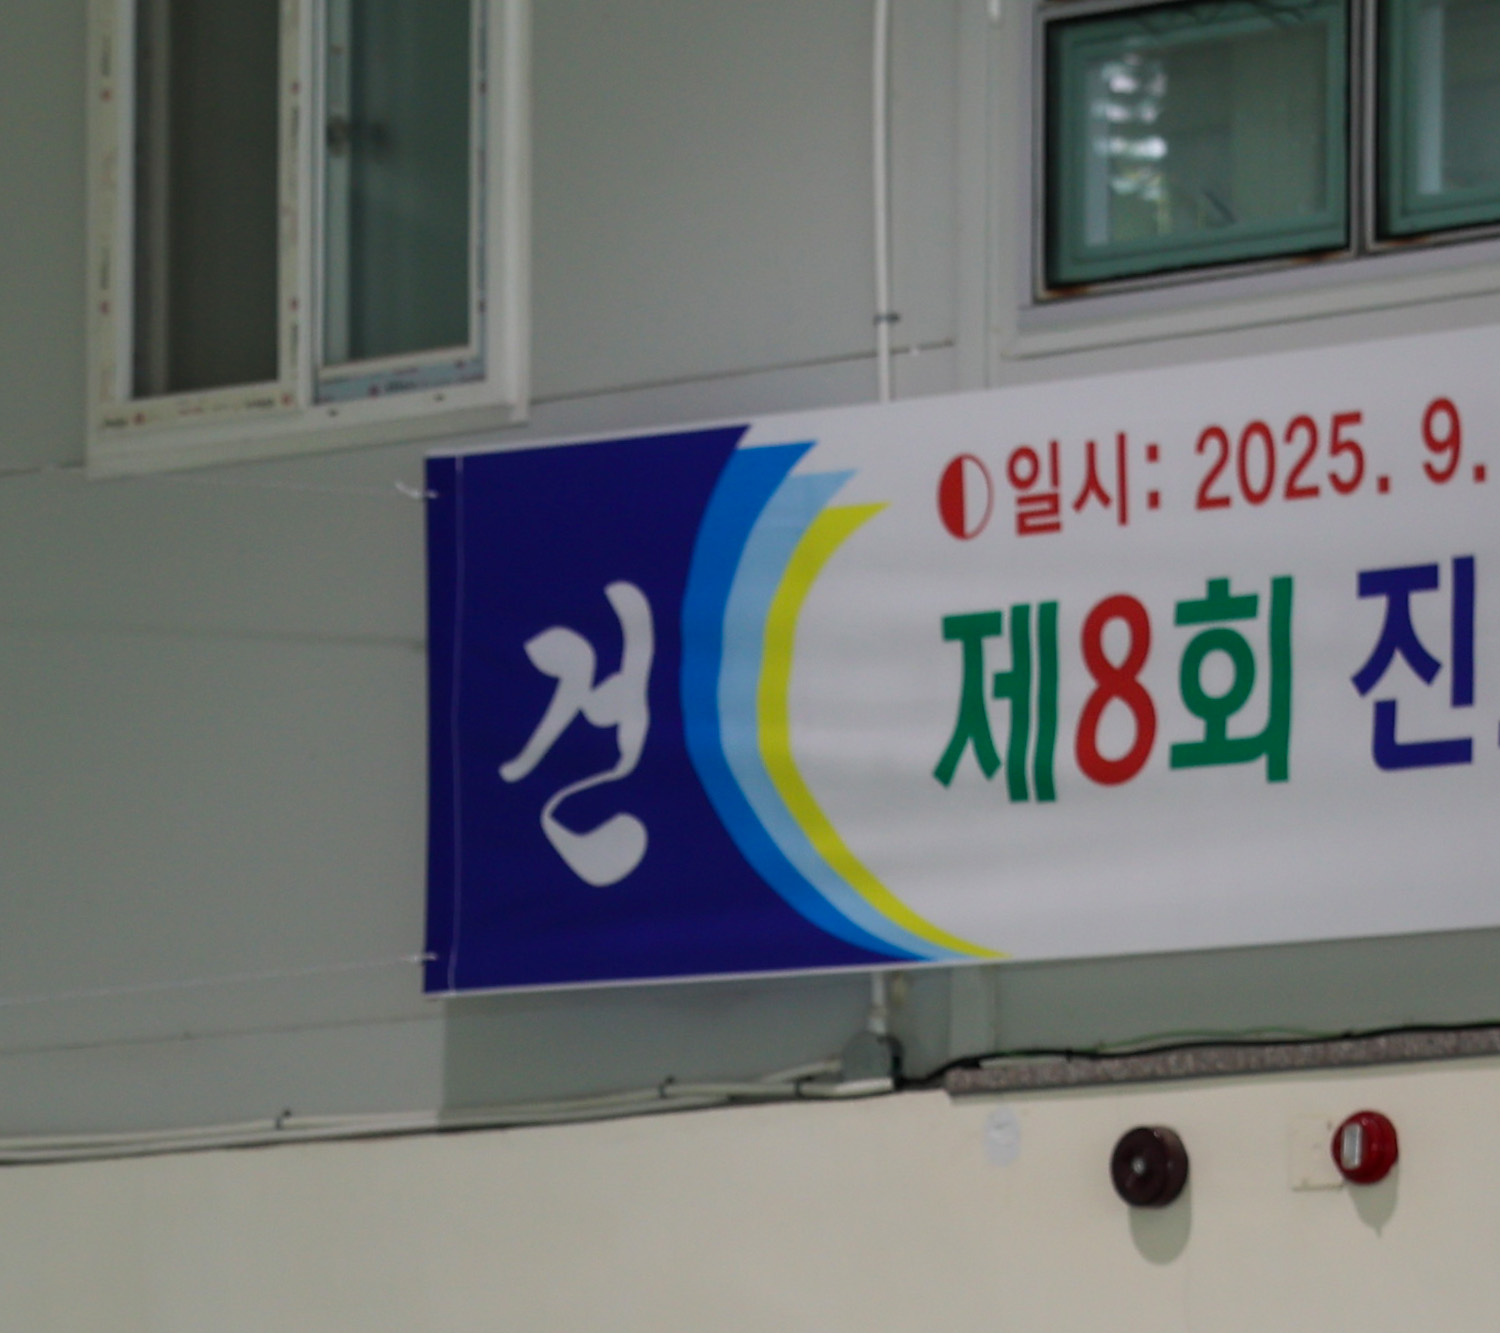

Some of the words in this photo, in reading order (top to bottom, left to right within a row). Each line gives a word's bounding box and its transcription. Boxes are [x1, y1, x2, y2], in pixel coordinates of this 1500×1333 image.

[1006, 432, 1161, 537] 일시:
[1195, 410, 1391, 511] 2025.
[1421, 396, 1487, 485] 9.
[932, 574, 1296, 804] 제8회
